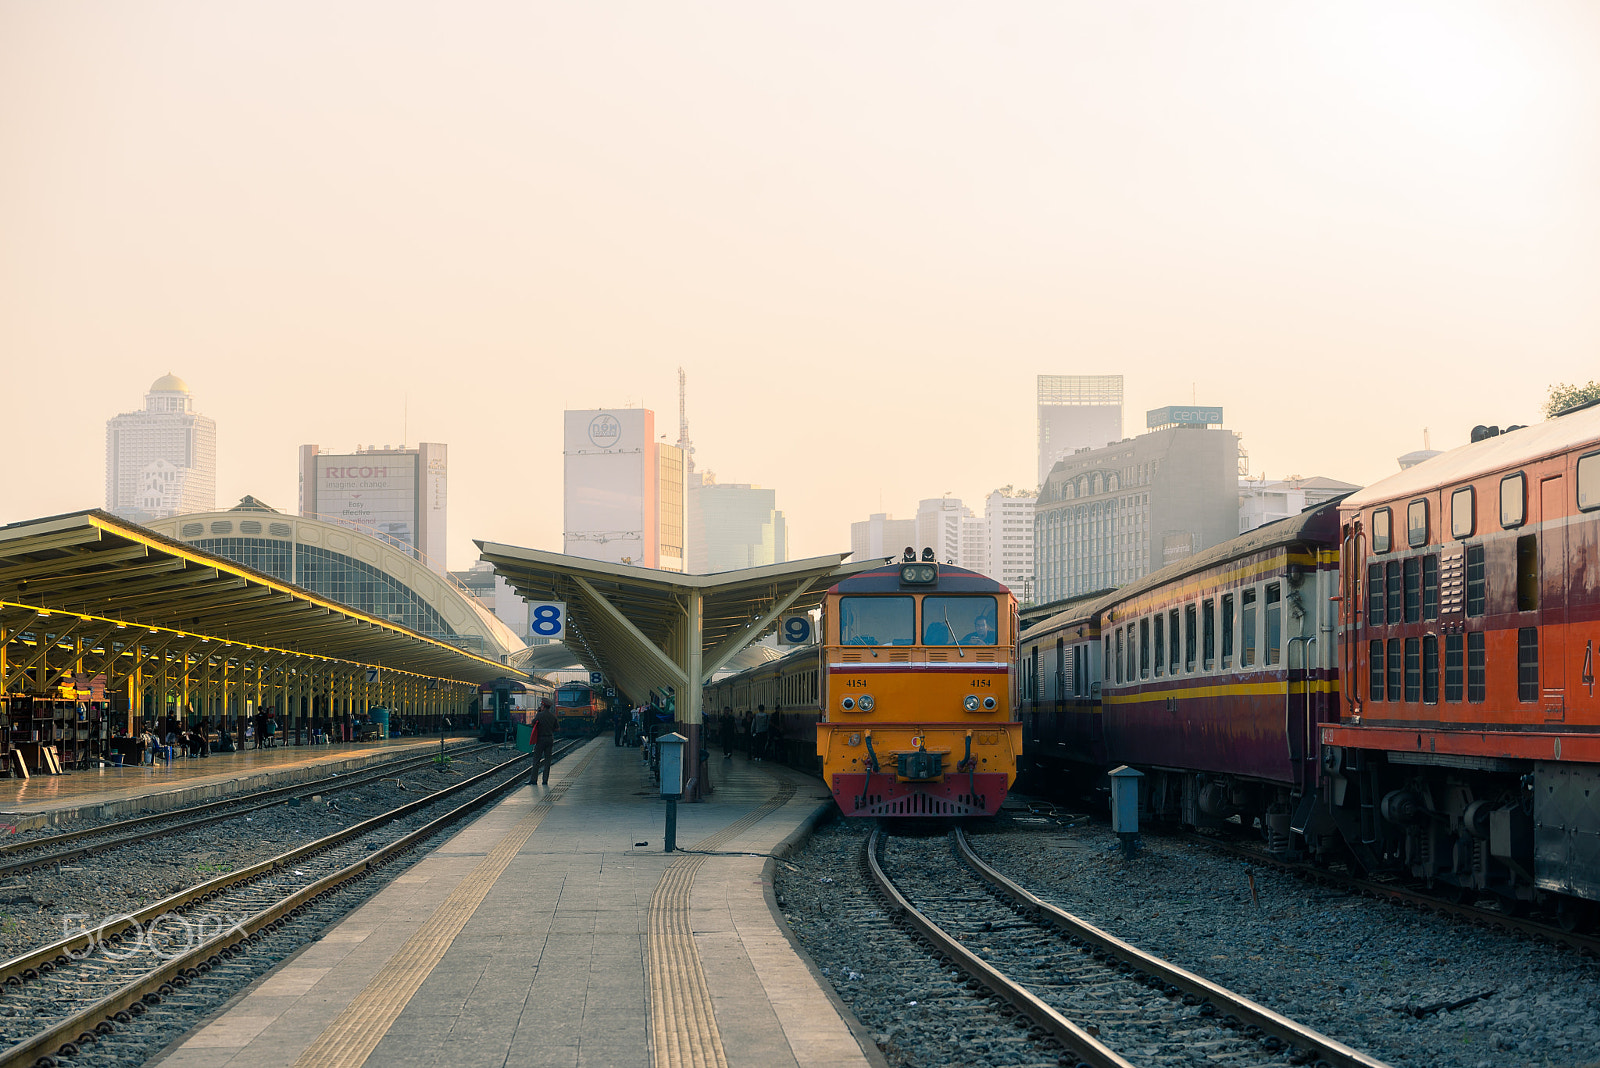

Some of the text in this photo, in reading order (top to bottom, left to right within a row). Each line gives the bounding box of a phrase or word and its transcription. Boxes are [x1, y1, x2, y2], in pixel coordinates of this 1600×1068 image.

[1173, 409, 1219, 421] centra
[326, 467, 387, 479] RICOH
[532, 605, 561, 635] 8
[785, 617, 810, 643] 9
[1582, 639, 1600, 698] 4
[367, 670, 377, 682] 7
[591, 672, 602, 684] 8
[846, 679, 867, 688] 4154
[970, 679, 991, 688] 4154
